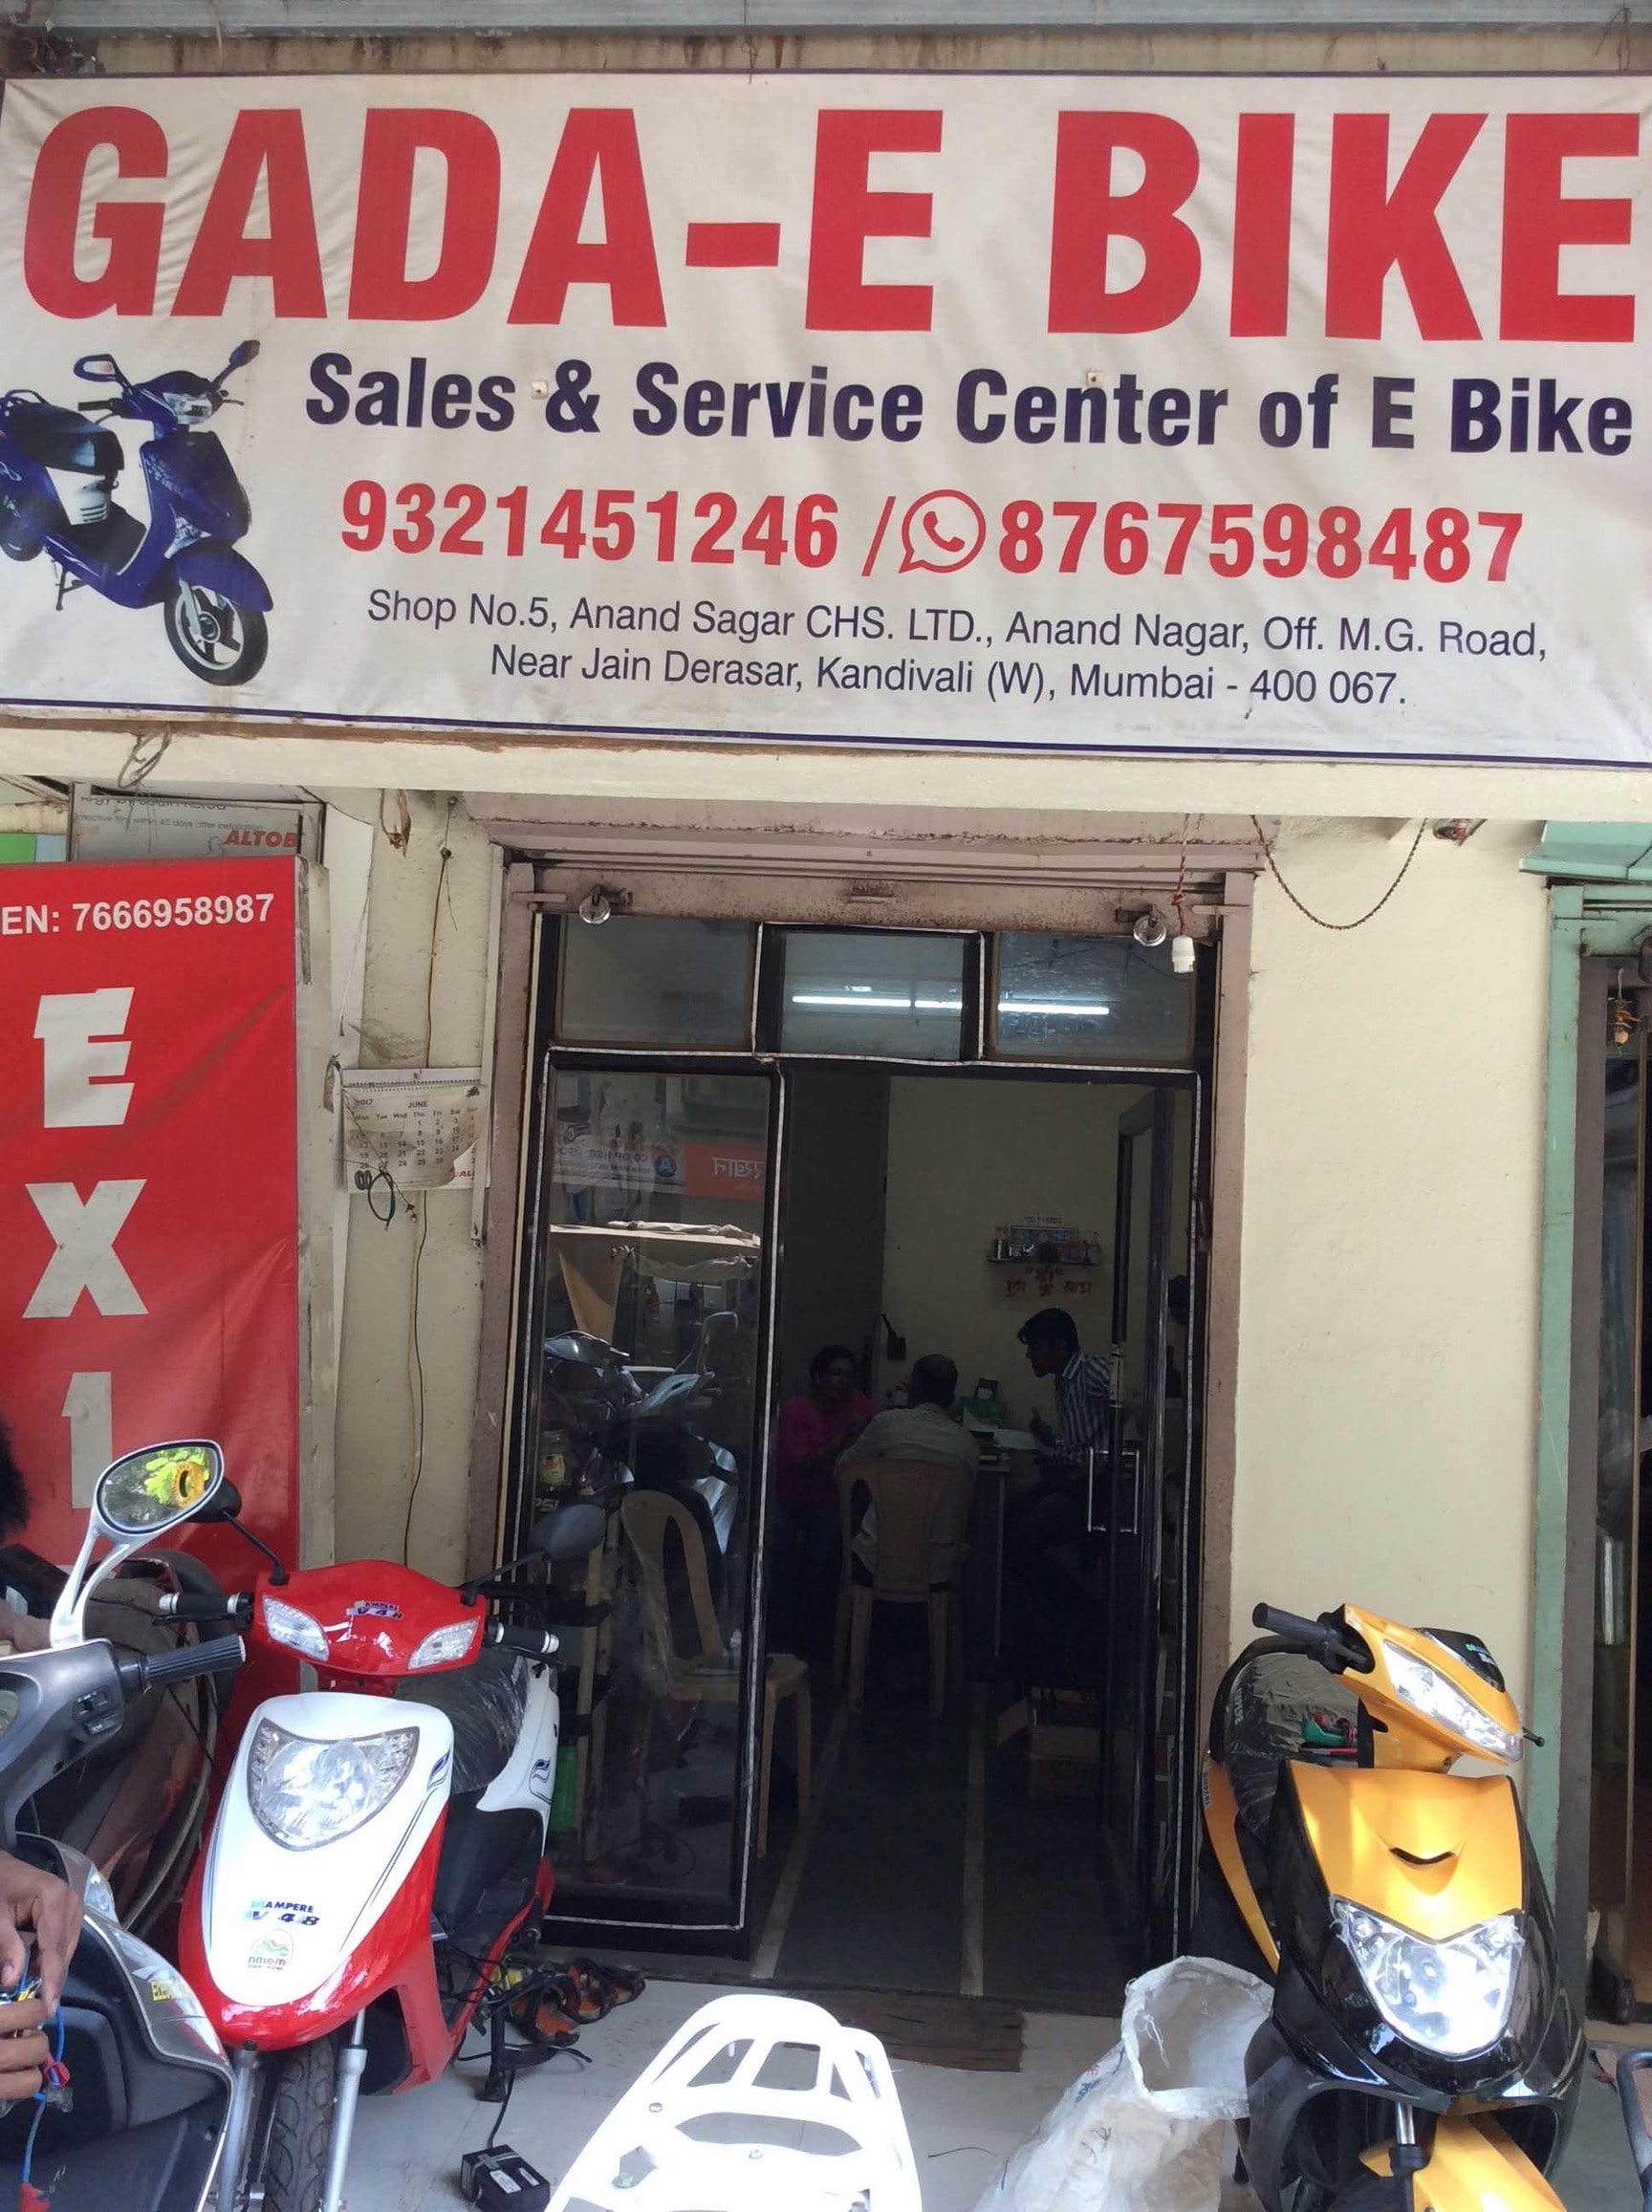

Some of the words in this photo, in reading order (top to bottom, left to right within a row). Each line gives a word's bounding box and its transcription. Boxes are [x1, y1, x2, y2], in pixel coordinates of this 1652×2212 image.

[1047, 111, 1640, 344] BIKE
[306, 353, 515, 432] Sales
[542, 359, 600, 433] &
[633, 362, 923, 442] Service
[957, 368, 1228, 446] Center
[1259, 374, 1338, 448] of
[1372, 377, 1415, 449] E
[1451, 378, 1632, 456] Bike
[341, 480, 837, 569] 9321451246
[998, 500, 1522, 583] 8767598487
[368, 589, 456, 630] Shop
[470, 594, 556, 633] No.5,
[570, 597, 680, 632] Anand
[693, 600, 794, 643] Sagar
[807, 605, 893, 639] CHS.
[909, 609, 991, 647] LTD.,
[1006, 611, 1120, 645] Anand
[1136, 614, 1248, 656] Nagar,
[1264, 617, 1322, 649] Off.
[1340, 618, 1423, 652] M.G.
[1441, 621, 1545, 661] Road,
[491, 644, 573, 678] Near
[581, 647, 650, 681] Jain
[664, 650, 801, 692] Derasar,
[817, 657, 972, 692] Kandivali
[989, 661, 1054, 704] (W),
[1072, 663, 1213, 699] Mumbai
[1250, 669, 1316, 702] 400
[1330, 671, 1404, 704] 067.
[1, 904, 61, 935] EN:
[72, 893, 275, 931] 7666958987
[354, 1098, 374, 1107] 2017
[265, 1900, 315, 1914] AMPERE
